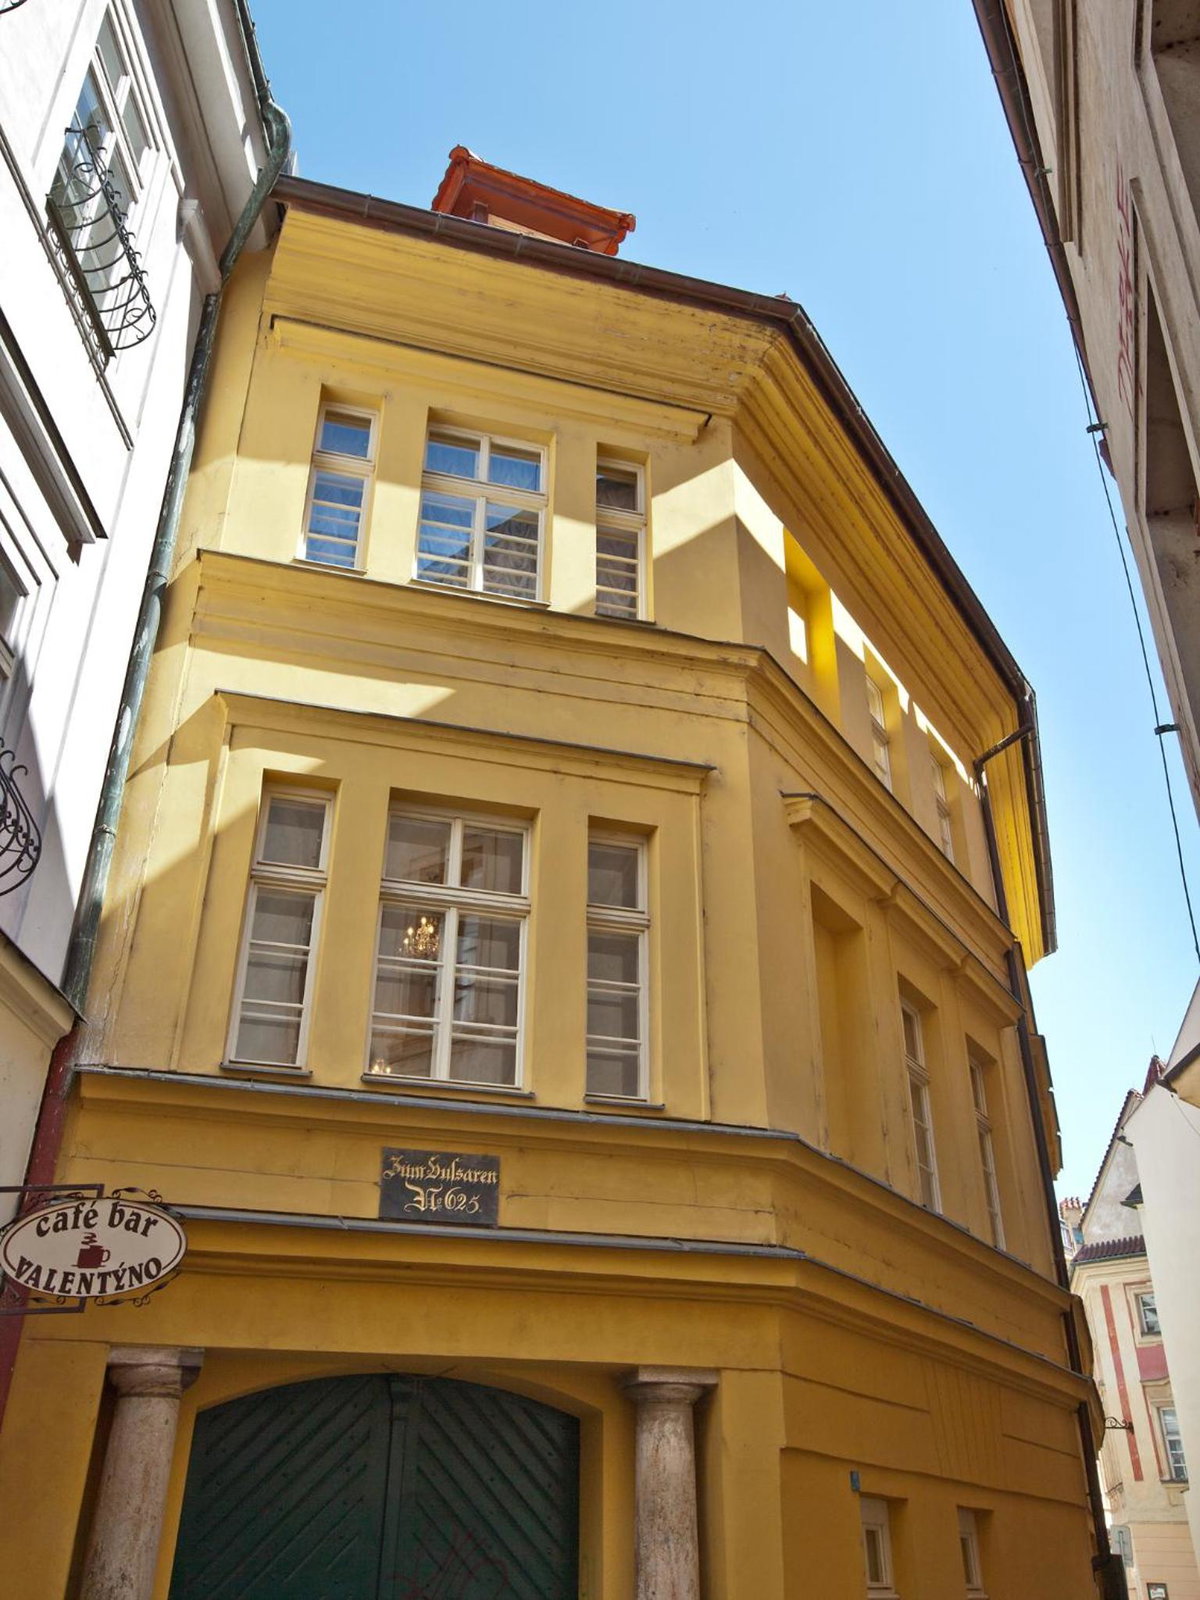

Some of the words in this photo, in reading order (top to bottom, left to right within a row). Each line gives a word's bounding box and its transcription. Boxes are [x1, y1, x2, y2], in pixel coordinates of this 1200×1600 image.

[36, 1200, 98, 1238] café
[108, 1201, 159, 1237] bar
[15, 1255, 162, 1295] VALENTÝNO
